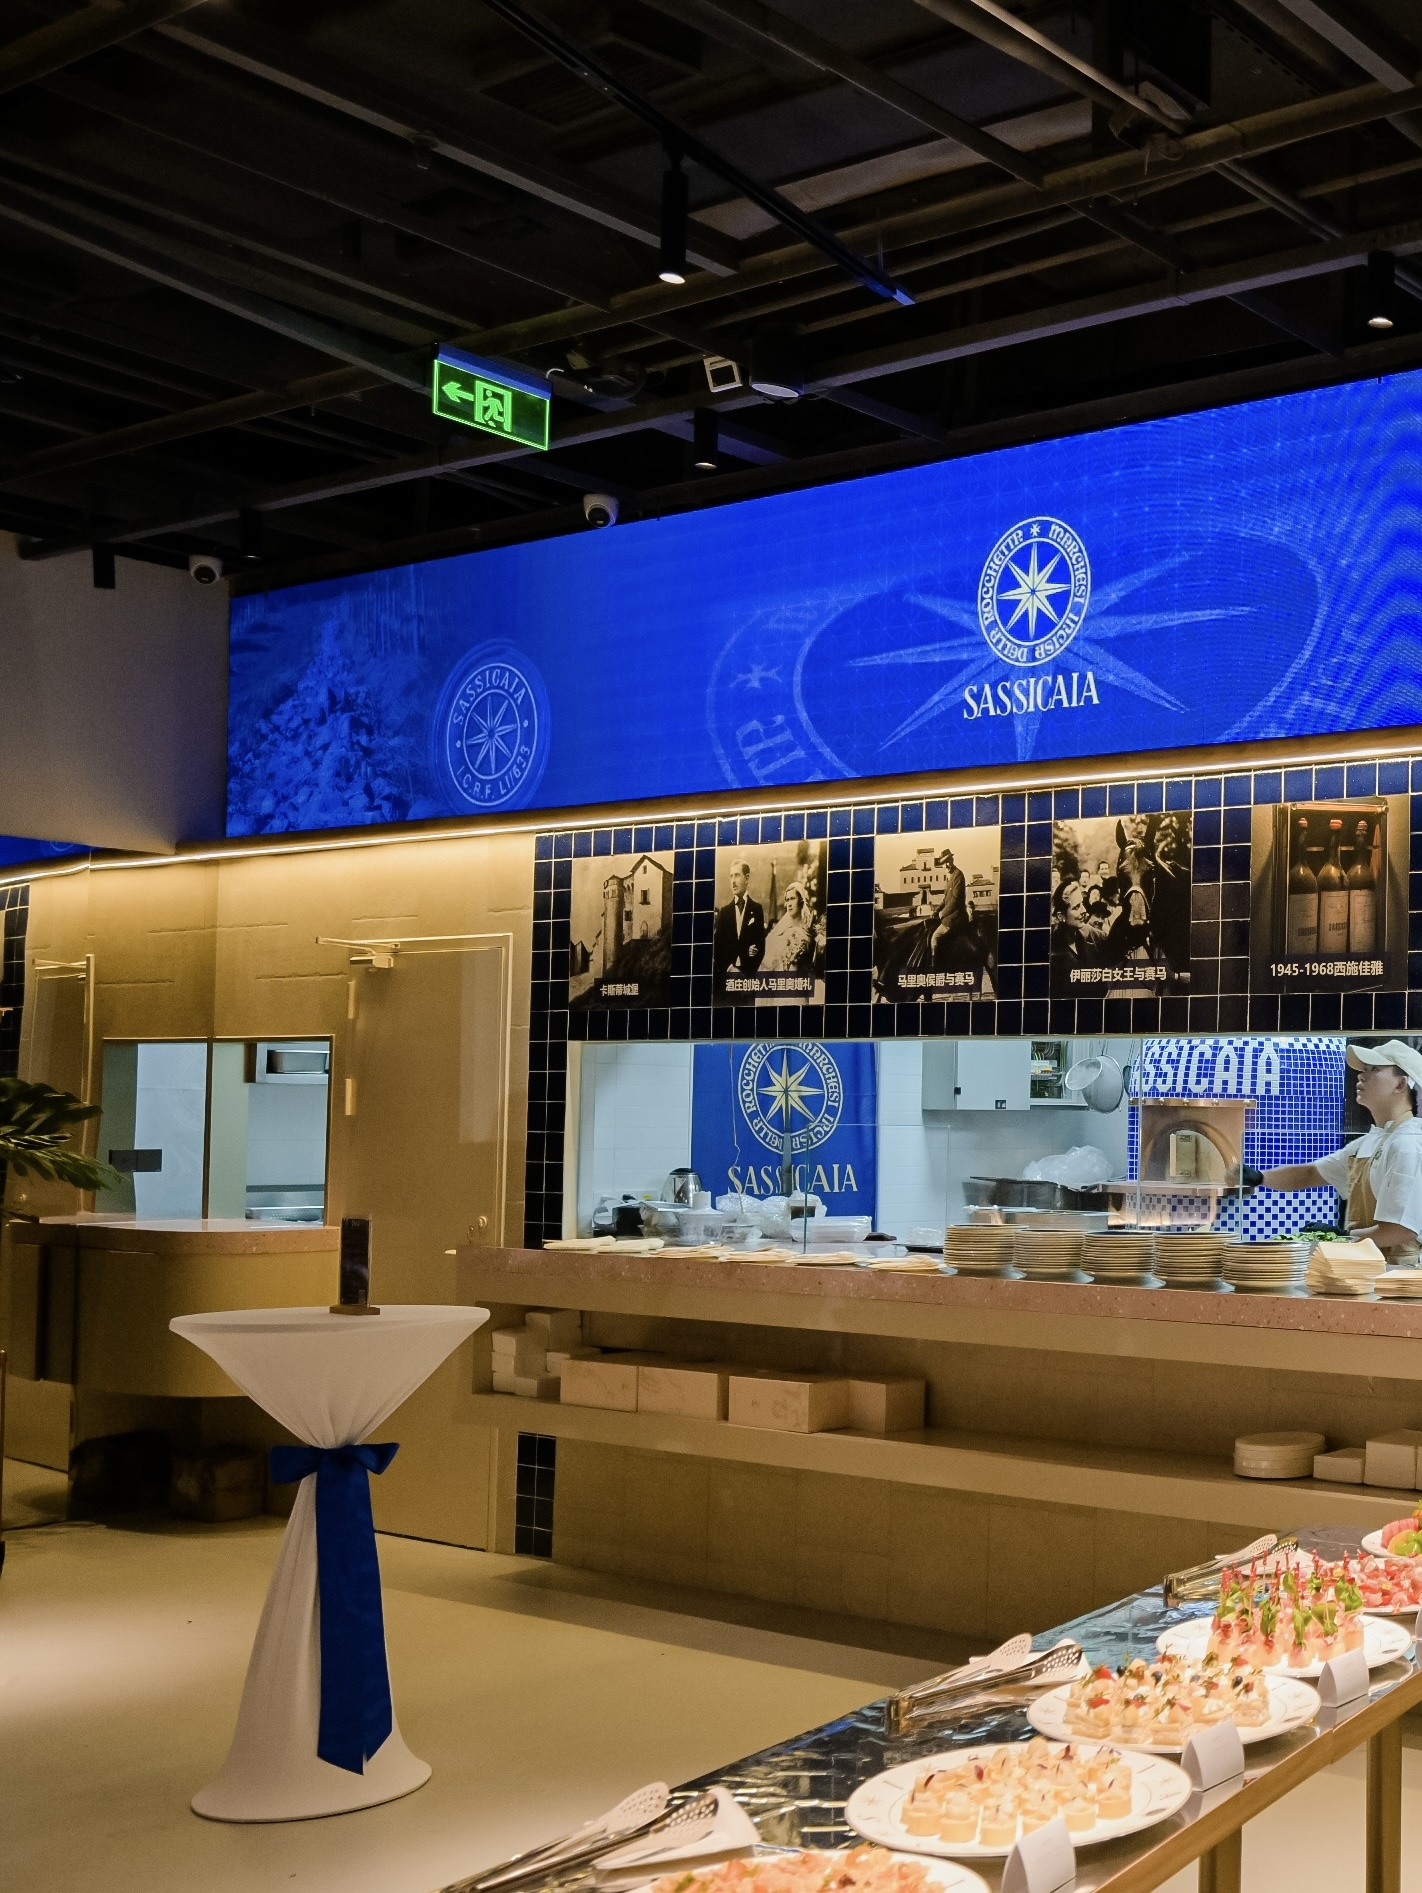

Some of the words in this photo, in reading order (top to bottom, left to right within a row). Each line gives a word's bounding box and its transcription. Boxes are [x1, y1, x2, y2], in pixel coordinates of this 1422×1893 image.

[453, 668, 527, 726] SASSICAIA
[963, 671, 1101, 720] SASSICAIA
[1069, 966, 1167, 983] 伊丽莎白女王与赛马
[1270, 960, 1384, 977] 1945-1968西施佳雅
[725, 977, 812, 992] 酒庄创始人马里奥婚礼
[897, 971, 975, 988] 马里奥侯爵与赛马
[599, 983, 640, 997] 卡斯蒂城堡
